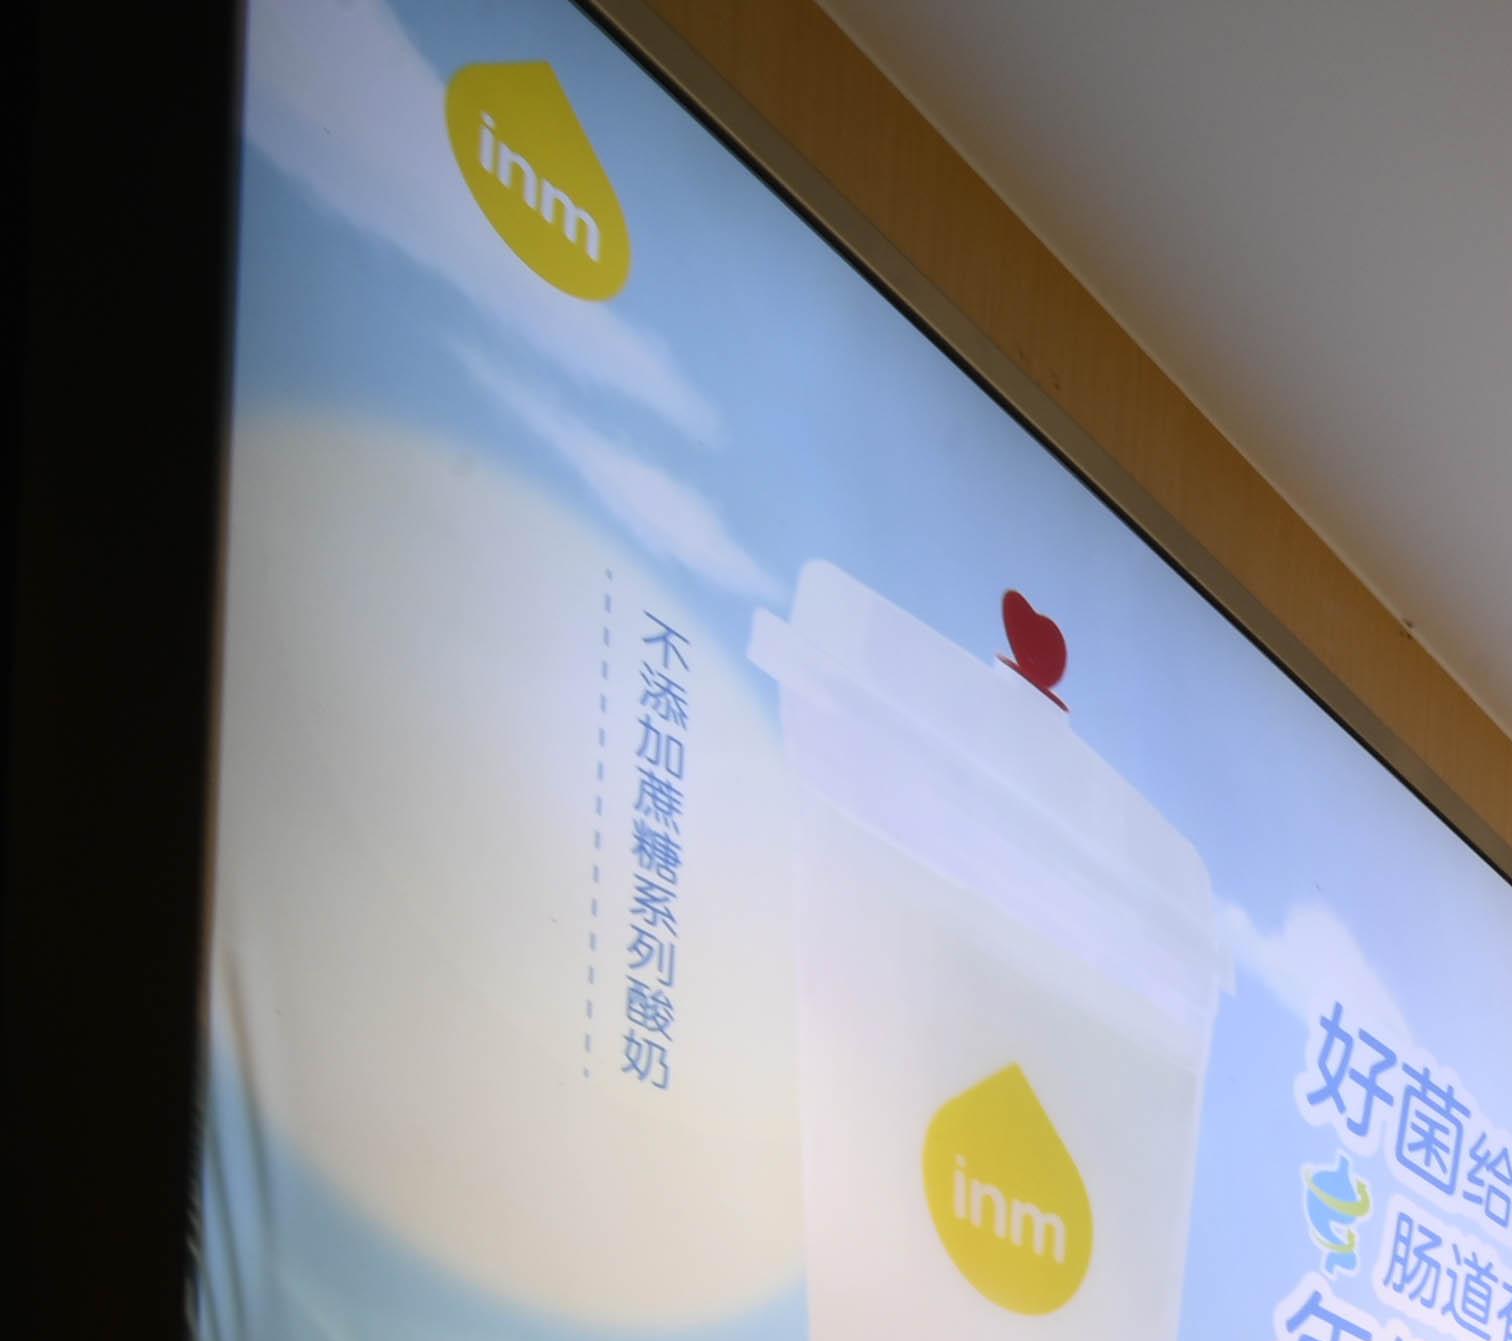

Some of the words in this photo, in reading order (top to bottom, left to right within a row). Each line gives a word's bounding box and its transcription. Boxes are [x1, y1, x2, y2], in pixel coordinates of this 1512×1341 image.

[479, 112, 600, 263] inm
[620, 609, 691, 1092] 不添加蔗糖系列酸奶
[952, 1155, 1067, 1264] inm
